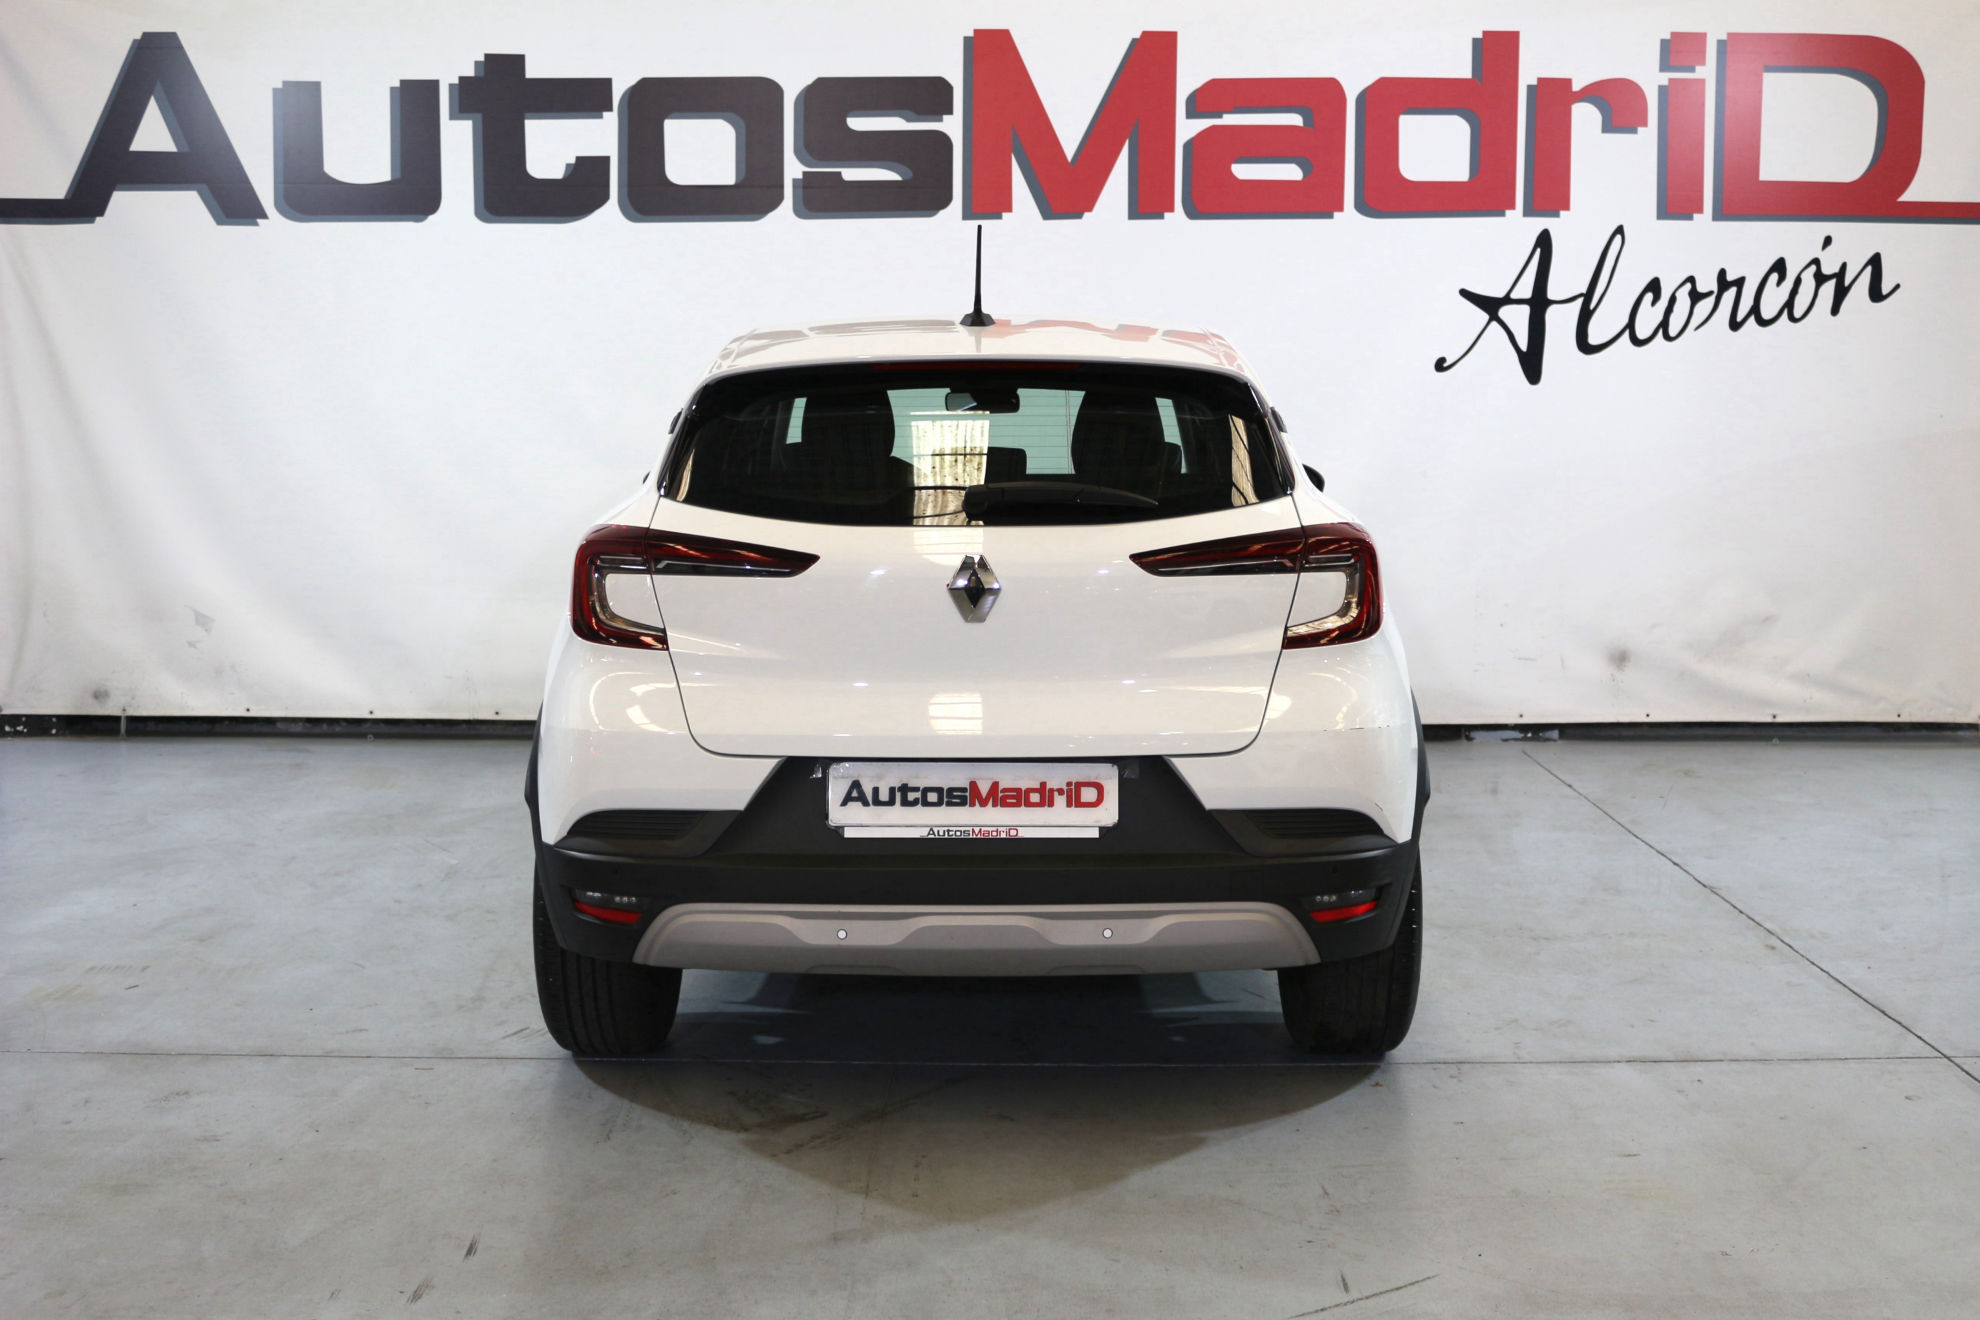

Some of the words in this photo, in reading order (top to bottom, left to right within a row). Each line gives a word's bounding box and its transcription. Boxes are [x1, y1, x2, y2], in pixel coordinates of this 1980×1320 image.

[0, 29, 1980, 226] AutosMadriD
[1434, 225, 1901, 385] Alcorcón
[840, 780, 1105, 808] AutosMadriD
[924, 827, 1021, 838] AutosMadriD
